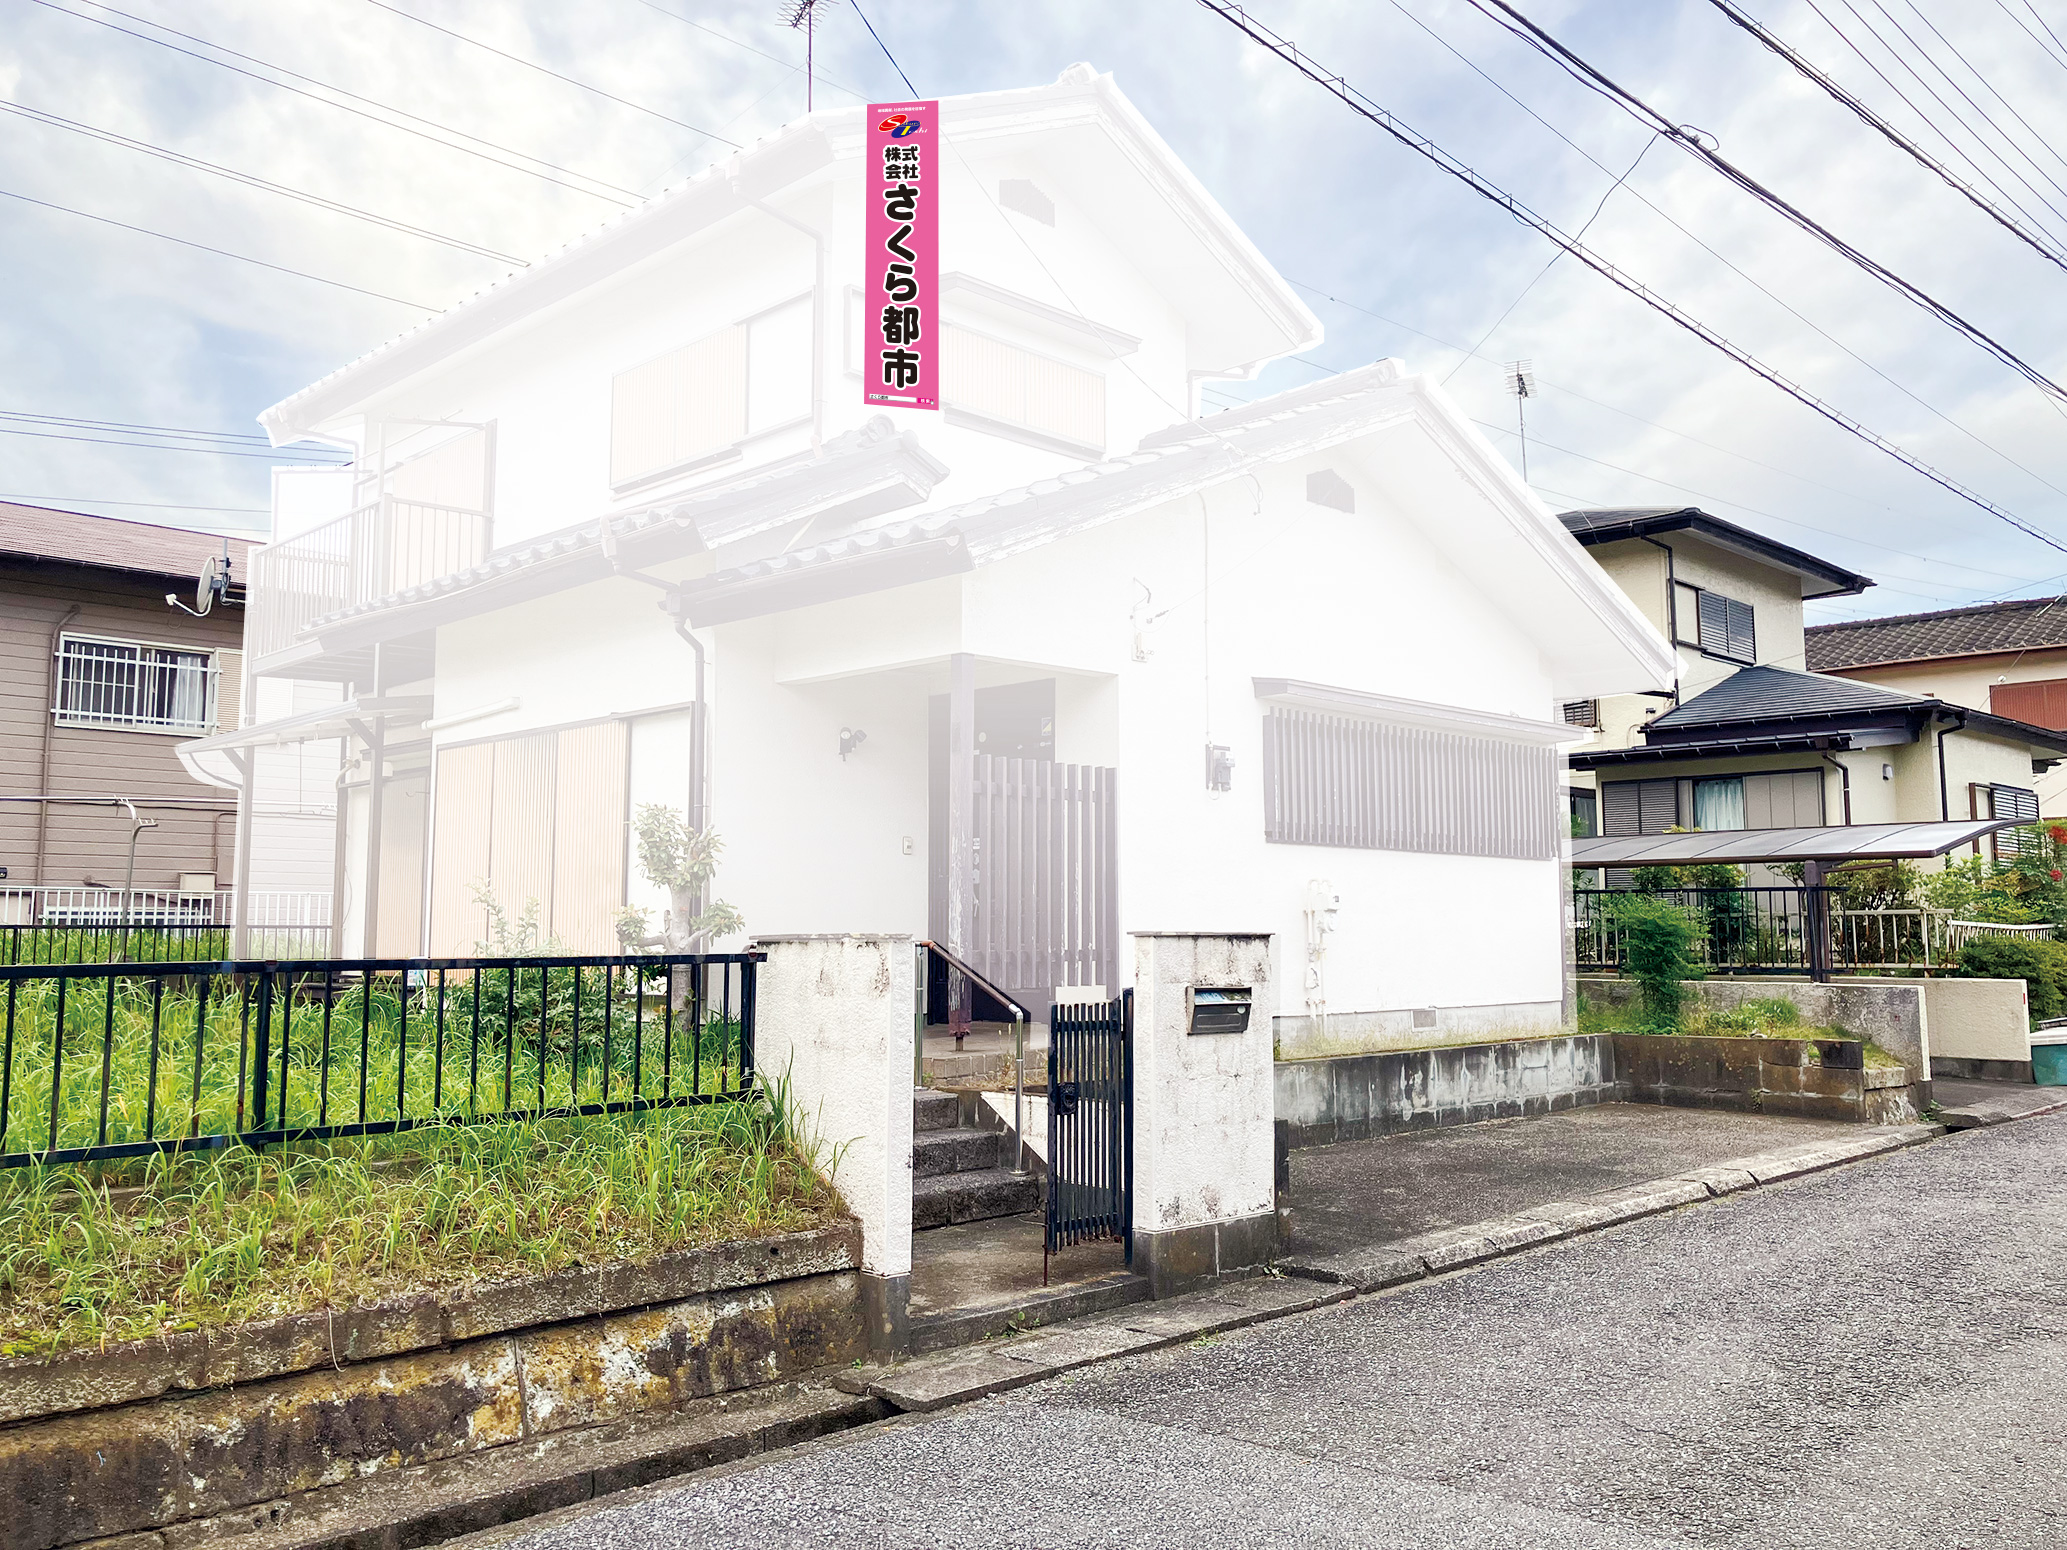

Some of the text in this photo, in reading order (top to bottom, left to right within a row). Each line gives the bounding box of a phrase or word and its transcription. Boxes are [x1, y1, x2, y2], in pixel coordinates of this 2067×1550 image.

[884, 145, 918, 162] 株式
[885, 163, 918, 180] 会社
[882, 183, 919, 389] さくら都市
